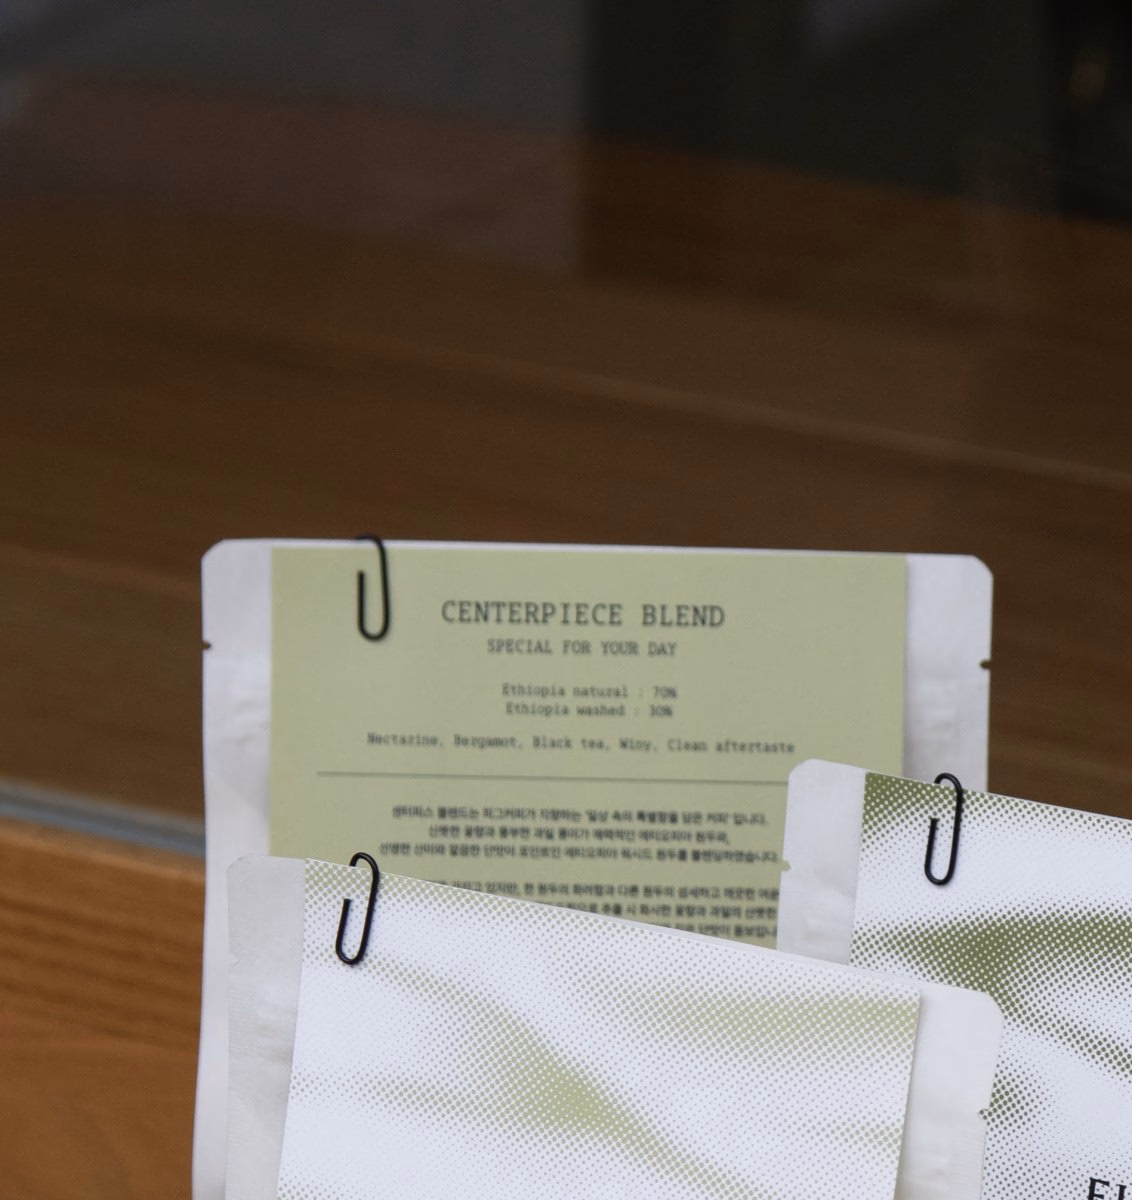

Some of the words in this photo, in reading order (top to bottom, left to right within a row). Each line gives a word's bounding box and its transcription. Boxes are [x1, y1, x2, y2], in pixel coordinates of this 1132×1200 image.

[442, 600, 622, 626] CENTERPIECE
[642, 604, 725, 628] BLEND
[488, 639, 552, 654] SPECIAL
[562, 640, 591, 655] FOR
[601, 641, 639, 655] YOUR
[648, 641, 677, 657] DAY
[502, 683, 566, 699] Ethiopia
[573, 685, 628, 699] natural
[506, 699, 570, 718] Ethiopia
[576, 704, 626, 717] washed
